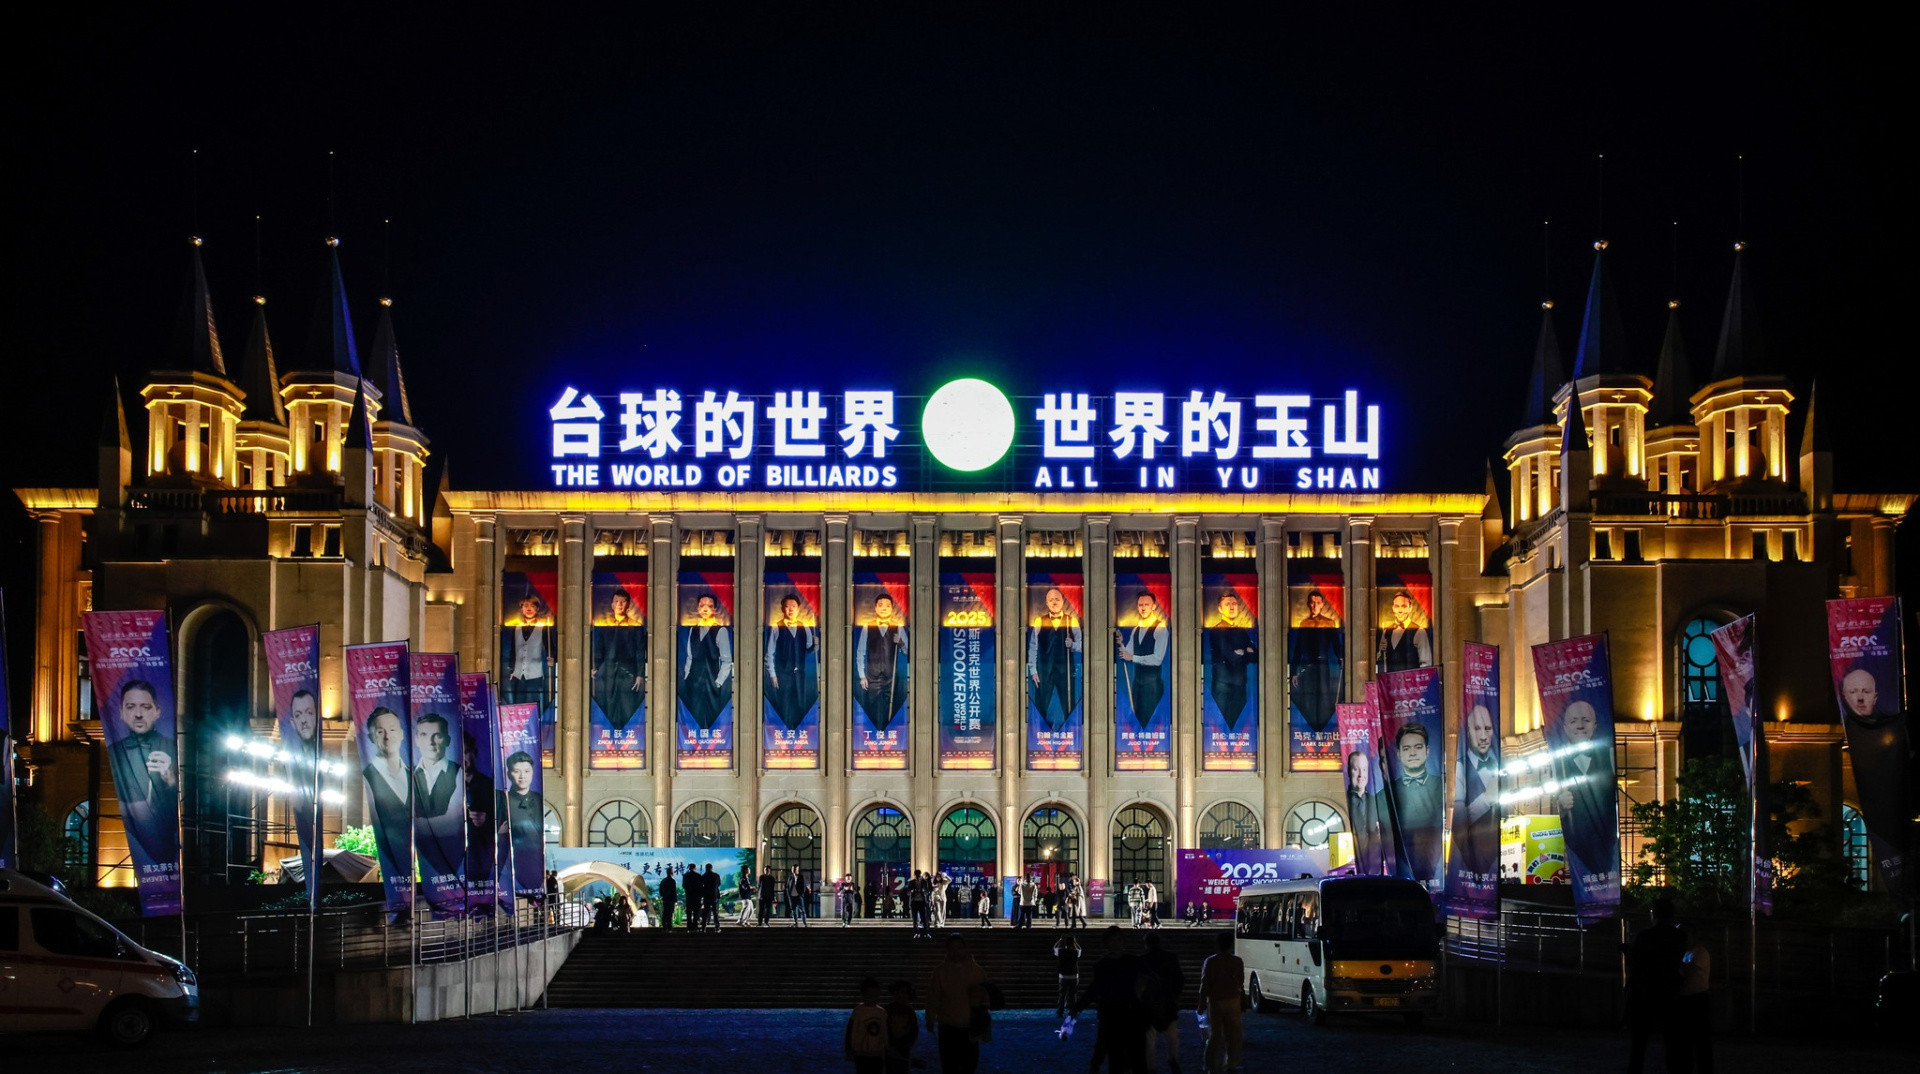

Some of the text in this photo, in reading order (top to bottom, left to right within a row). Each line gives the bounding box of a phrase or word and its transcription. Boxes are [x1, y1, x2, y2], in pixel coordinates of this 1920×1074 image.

[549, 387, 899, 459] 台球的世界
[1036, 390, 1379, 459] 世界的玉山
[552, 465, 897, 486] THE WORLD OF BILLIARDS
[1035, 467, 1379, 488] ALL IN YU SHAN
[948, 611, 986, 625] 2025
[953, 628, 966, 702] SNOOKER
[968, 628, 981, 730] 斯诺克世界公开赛
[1220, 862, 1278, 879] 2025
